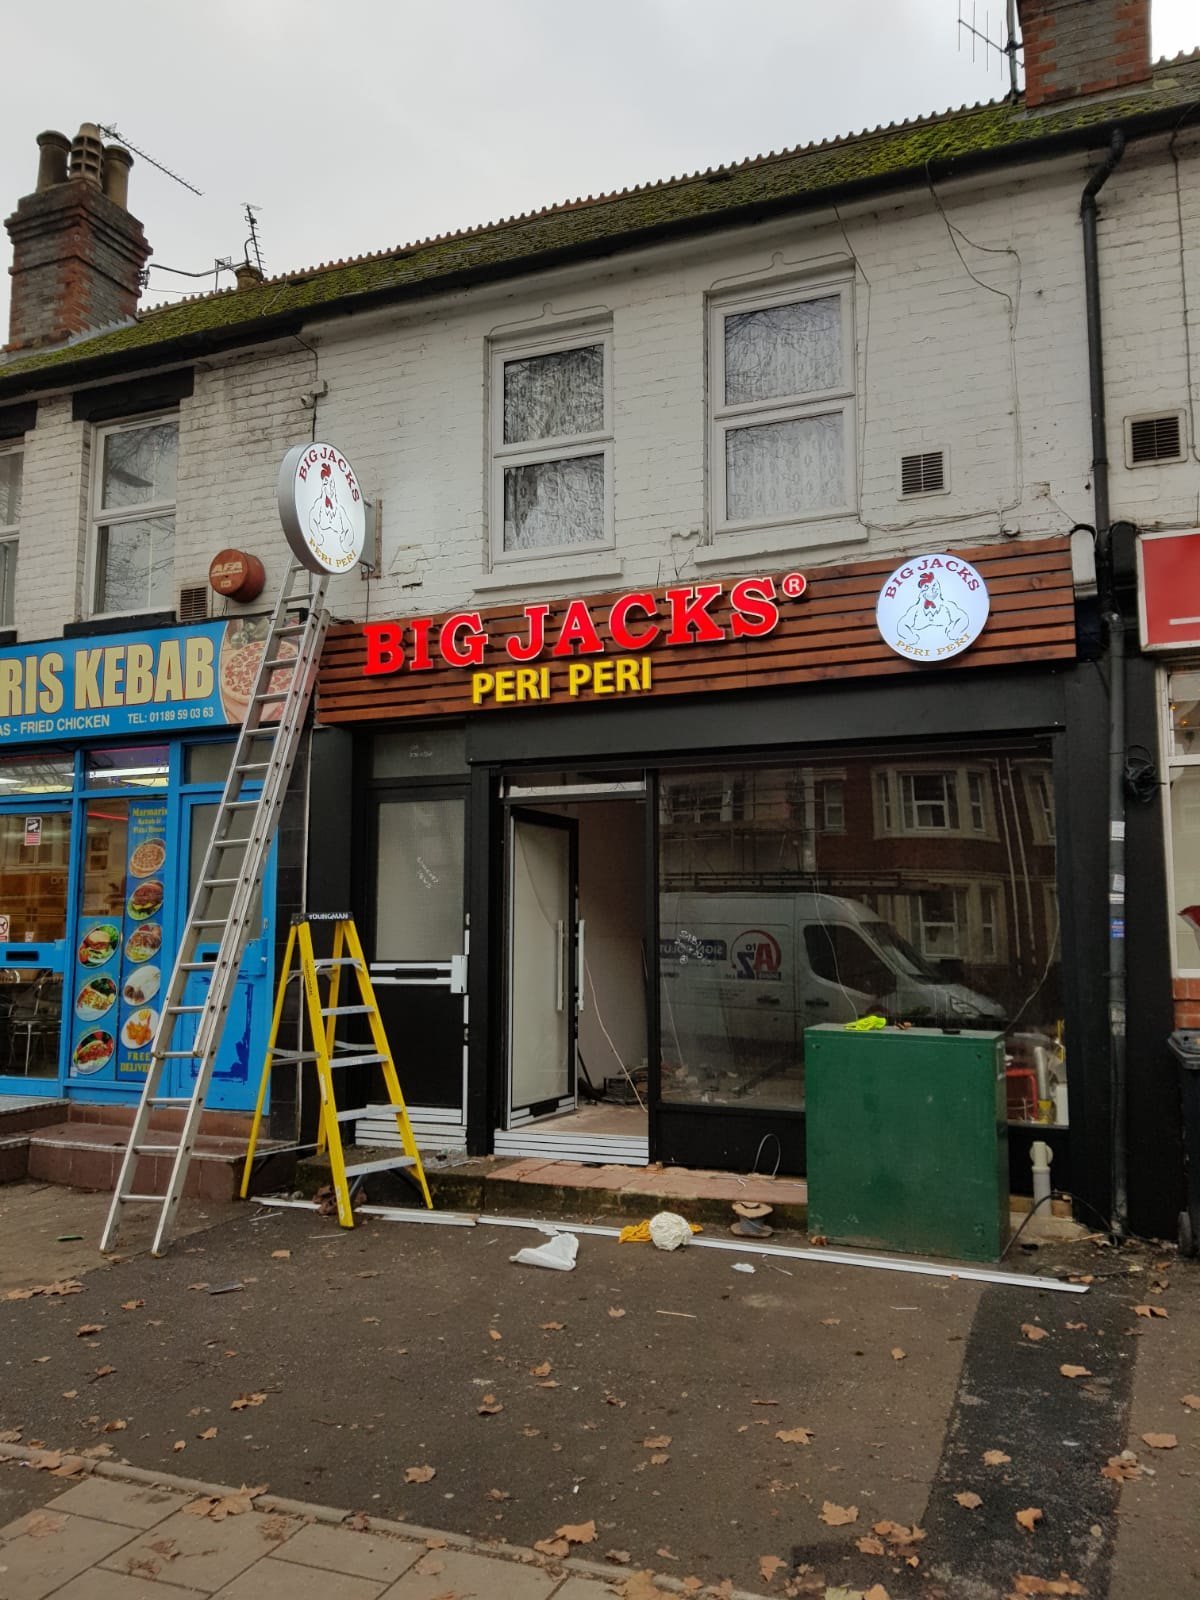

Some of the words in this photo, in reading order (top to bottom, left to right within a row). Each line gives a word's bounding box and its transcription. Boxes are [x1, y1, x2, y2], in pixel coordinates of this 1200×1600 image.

[299, 449, 318, 482] BIG
[320, 447, 360, 502] JACKS
[309, 537, 333, 566] PERI
[336, 549, 357, 568] PERI
[885, 567, 914, 599] BIG
[917, 558, 980, 592] JACKS
[363, 612, 488, 675] BIG
[506, 577, 779, 663] JACKS
[896, 640, 930, 656] PERI
[936, 632, 971, 656] PERI
[0, 652, 64, 717] RIS
[74, 637, 214, 710] KEBAB
[472, 666, 551, 705] PERI
[569, 656, 652, 697] PERI
[20, 719, 54, 735] FRIED
[56, 714, 110, 732] CHICKEN
[128, 712, 148, 725] TEL:
[149, 710, 175, 723] 01189
[177, 709, 188, 720] 59
[190, 708, 200, 719] 03
[203, 706, 214, 718] 63
[127, 1051, 151, 1061] FREE
